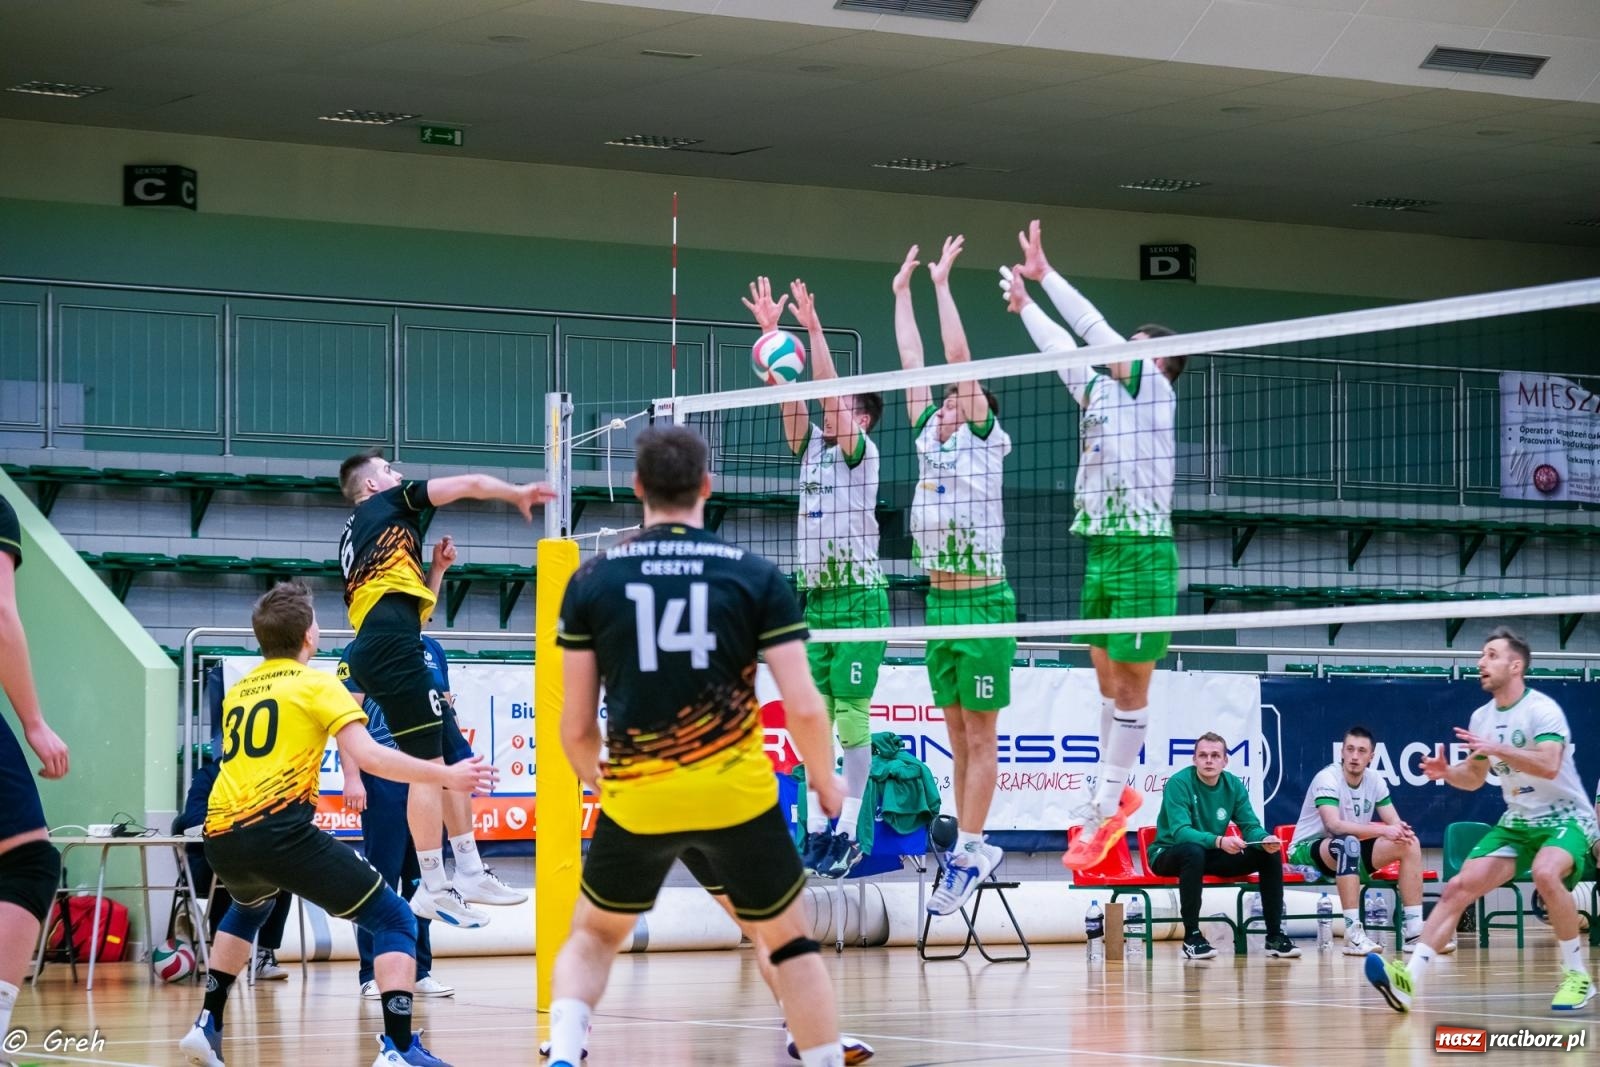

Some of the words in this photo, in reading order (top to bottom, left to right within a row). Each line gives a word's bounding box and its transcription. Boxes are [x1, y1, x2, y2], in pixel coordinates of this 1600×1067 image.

[134, 178, 166, 201] C
[181, 181, 194, 204] C
[1150, 256, 1180, 276] D
[1520, 425, 1554, 436] Operator
[1520, 436, 1561, 446] Pracownik
[641, 560, 704, 576] CIESZYN
[625, 582, 717, 672] 14
[850, 662, 863, 684] 6
[974, 675, 994, 699] 16
[428, 689, 442, 716] 6
[223, 699, 279, 764] 30
[1556, 826, 1568, 839] 7
